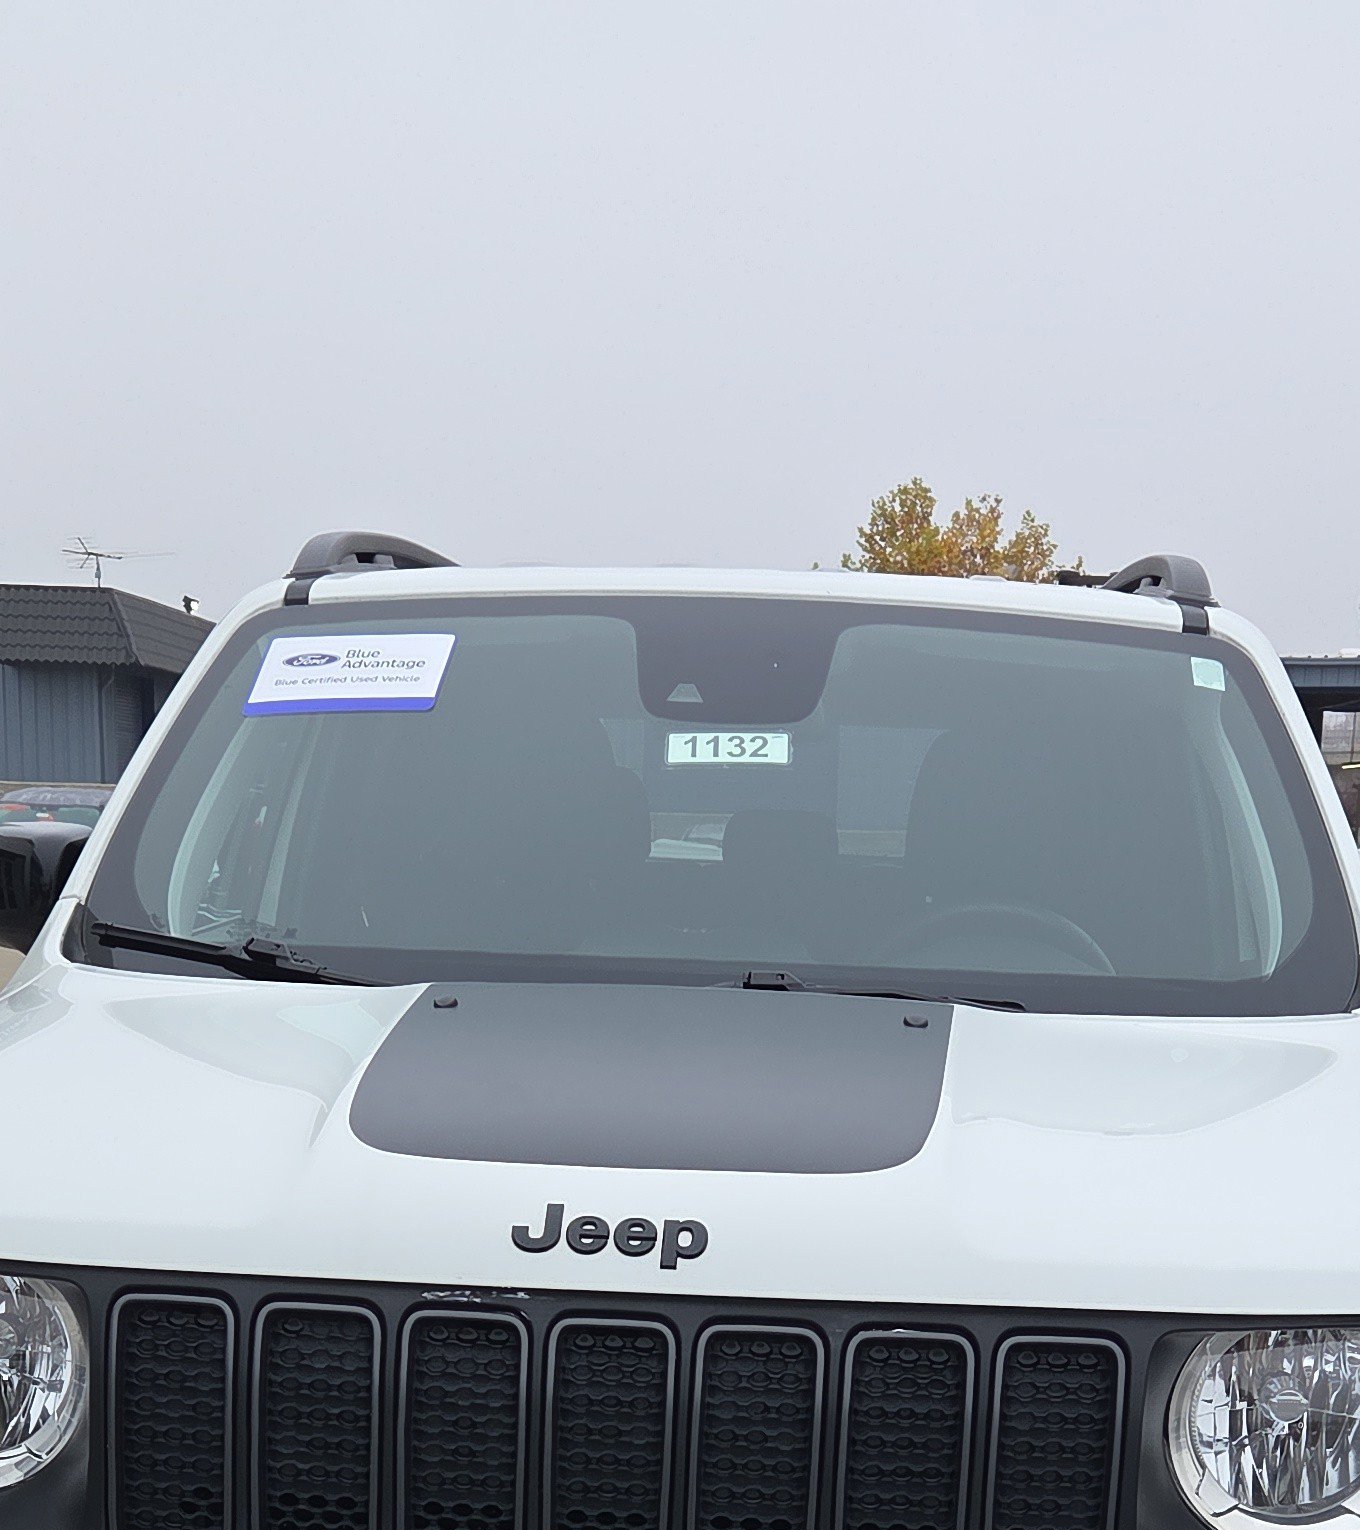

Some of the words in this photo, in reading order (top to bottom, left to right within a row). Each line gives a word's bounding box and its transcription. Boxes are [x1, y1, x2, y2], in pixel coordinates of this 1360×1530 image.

[345, 649, 381, 659] Blue
[341, 659, 426, 670] Advantage
[274, 678, 298, 687] Blue
[301, 675, 347, 686] Certified
[350, 675, 378, 684] Used
[382, 674, 421, 683] Vehicle
[683, 735, 769, 758] 1132
[511, 1203, 709, 1270] Jeep
